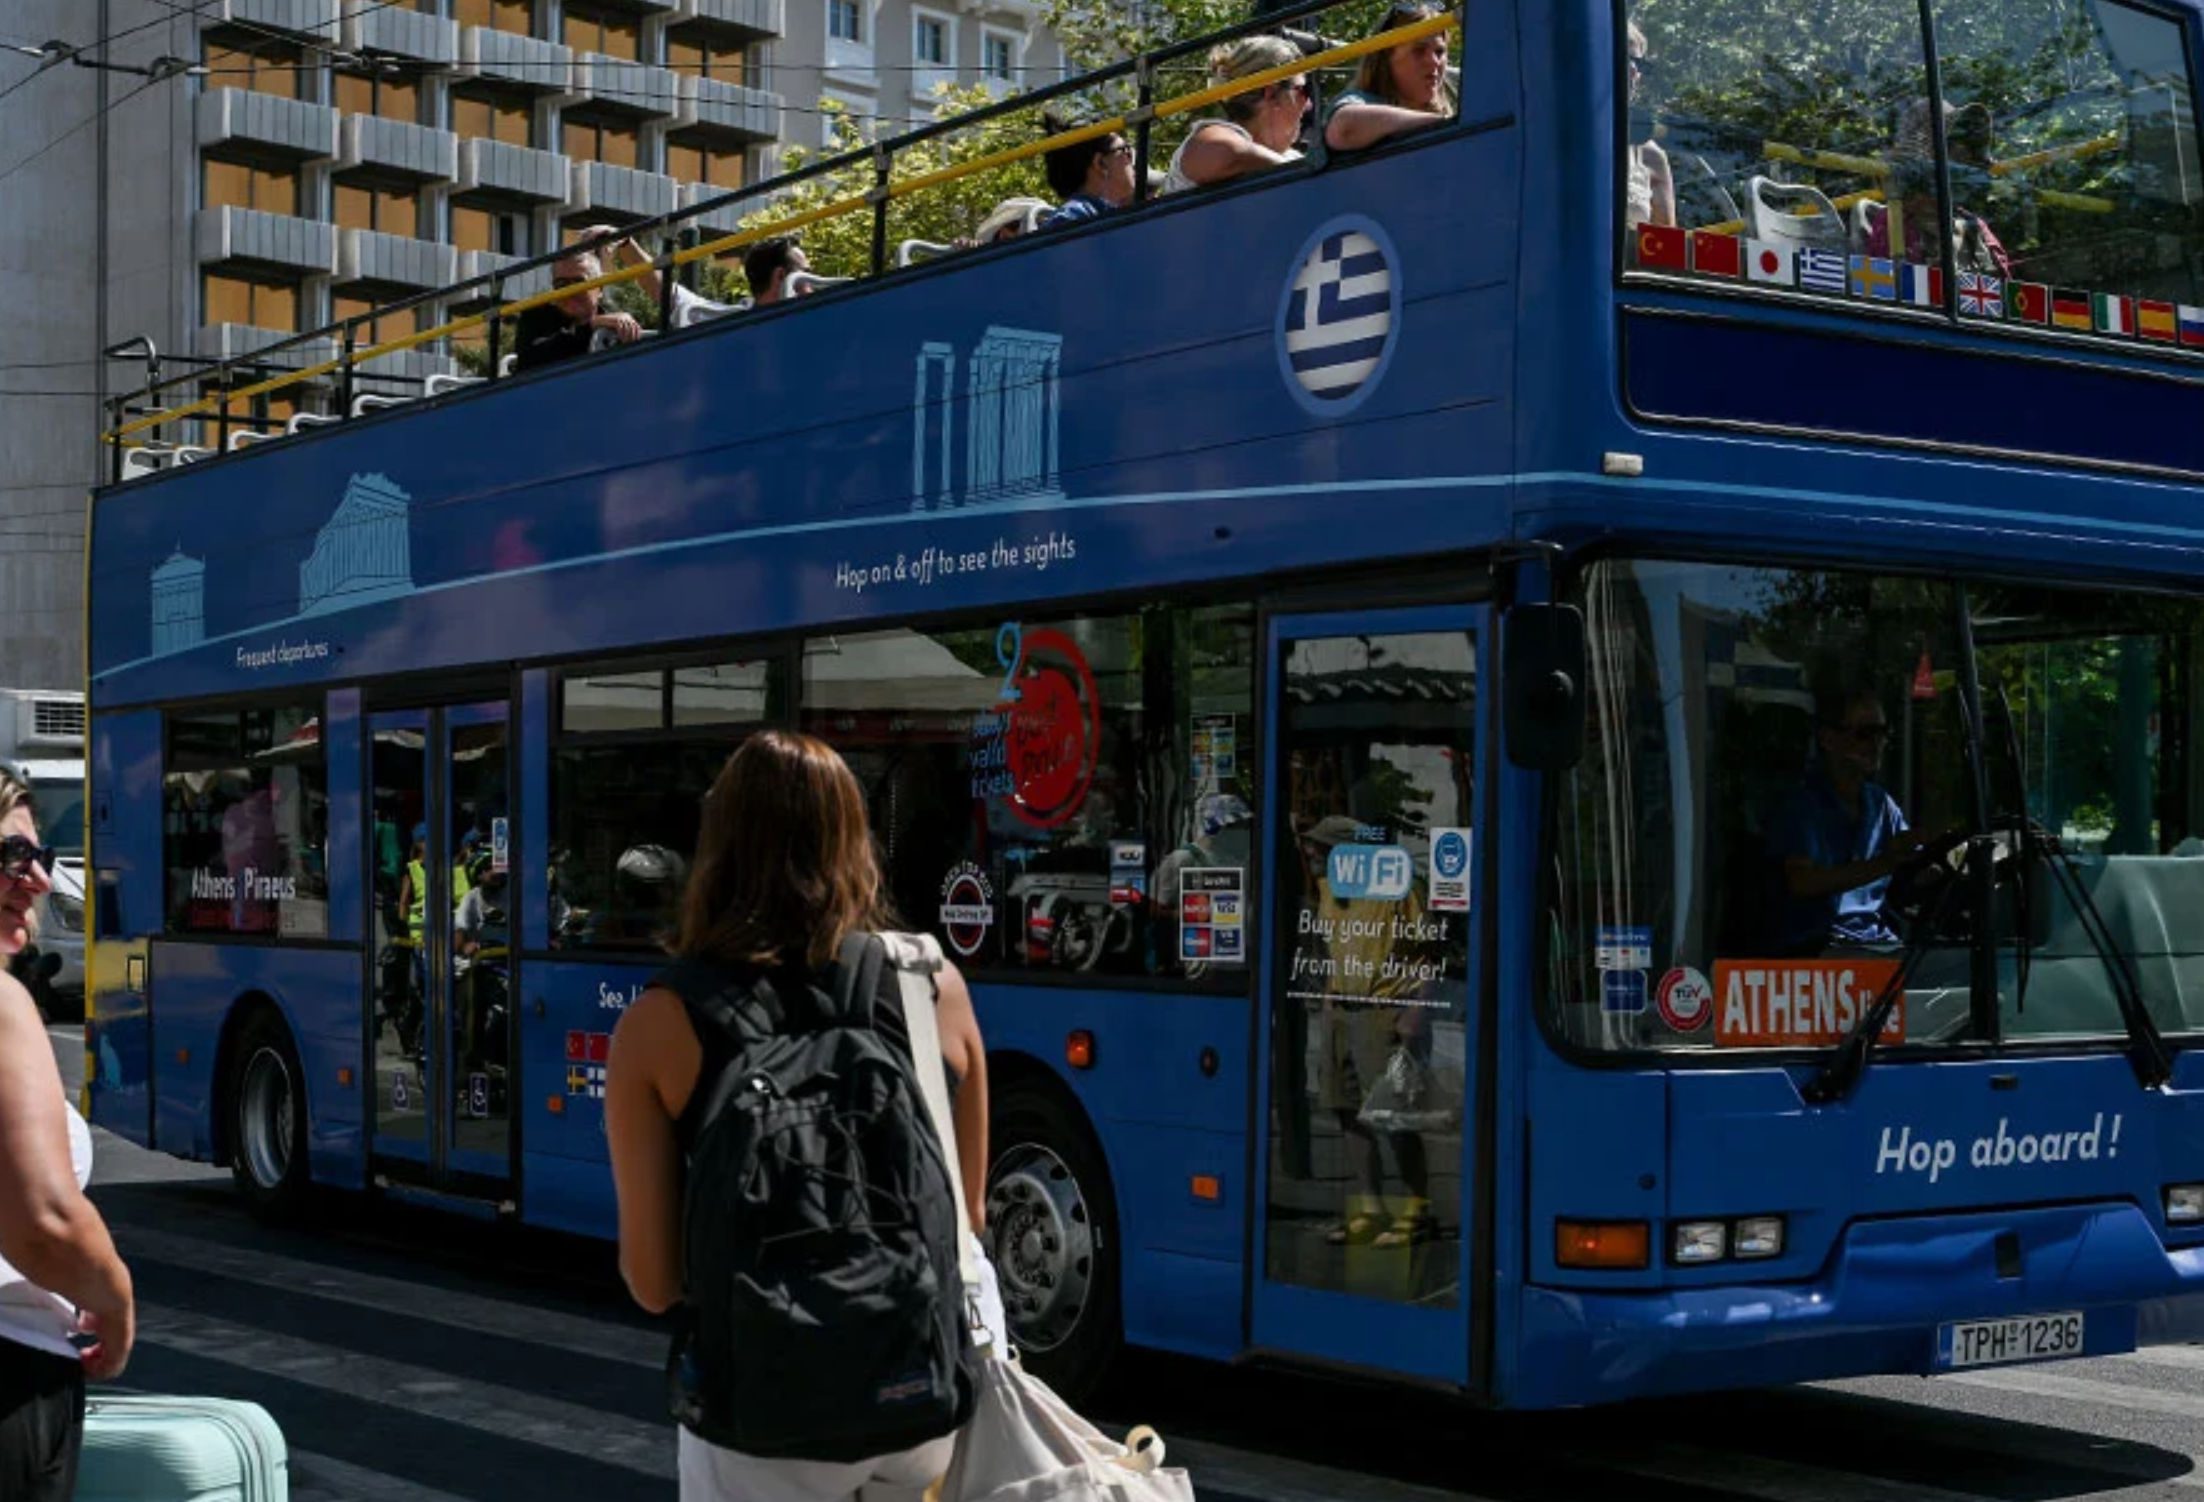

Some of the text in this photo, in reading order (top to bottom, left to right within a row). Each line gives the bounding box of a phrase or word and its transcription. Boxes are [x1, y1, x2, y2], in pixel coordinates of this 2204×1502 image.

[836, 532, 1077, 593] Hop on & off to see the sights
[1354, 826, 1387, 841] FREE
[191, 865, 297, 900] Athens Piraeus
[1298, 909, 1449, 943] Buy your ticket
[1289, 947, 1447, 982] from the driver!
[1675, 984, 1703, 998] TÜV
[1722, 969, 1857, 1035] ATHENS
[1875, 1126, 1956, 1183] Hop
